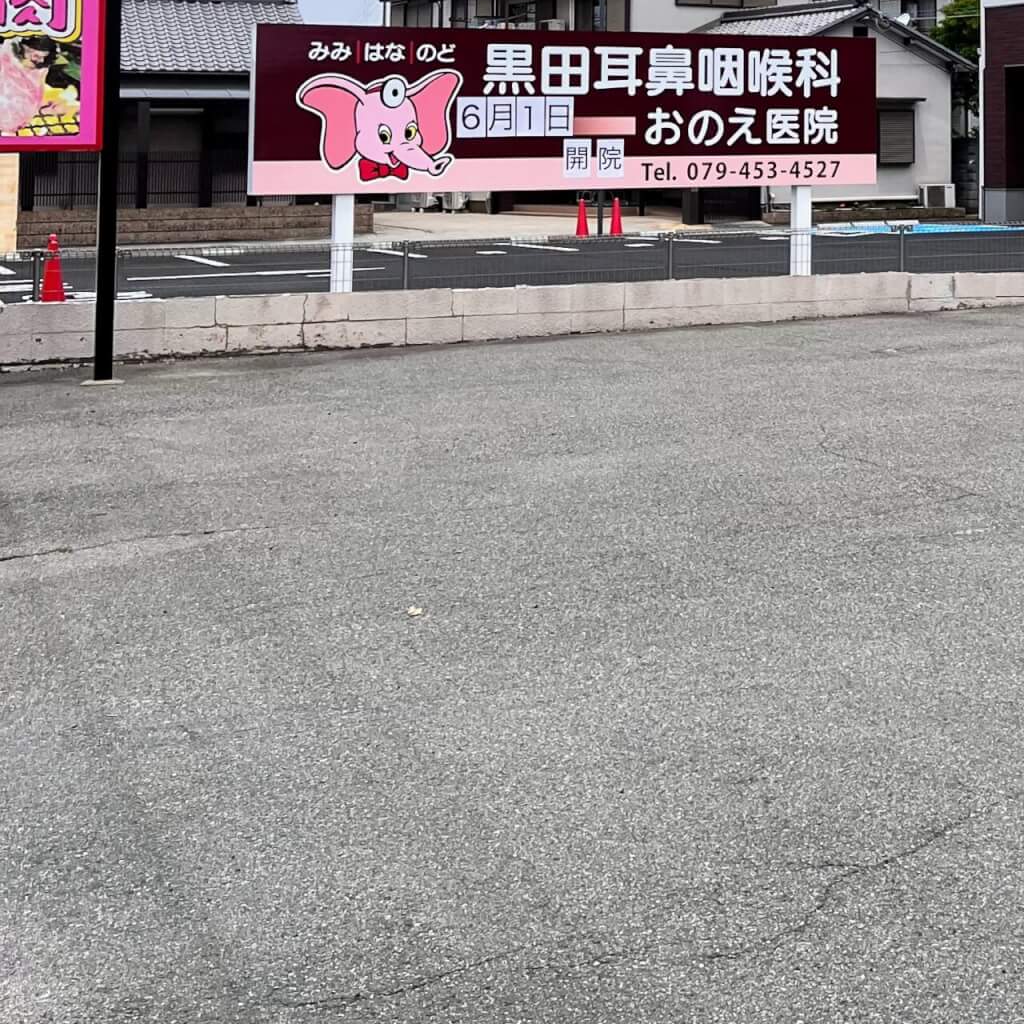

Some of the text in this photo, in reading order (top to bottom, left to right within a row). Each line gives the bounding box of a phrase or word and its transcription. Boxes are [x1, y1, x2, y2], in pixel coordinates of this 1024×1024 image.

[308, 41, 456, 63] みみ はな のど
[482, 43, 841, 97] 黒田耳鼻咽喉科
[462, 103, 570, 131] 6月1日
[644, 106, 840, 146] おのえ医院
[566, 146, 622, 170] 開院
[641, 160, 841, 182] Tel. 079-453-4527
